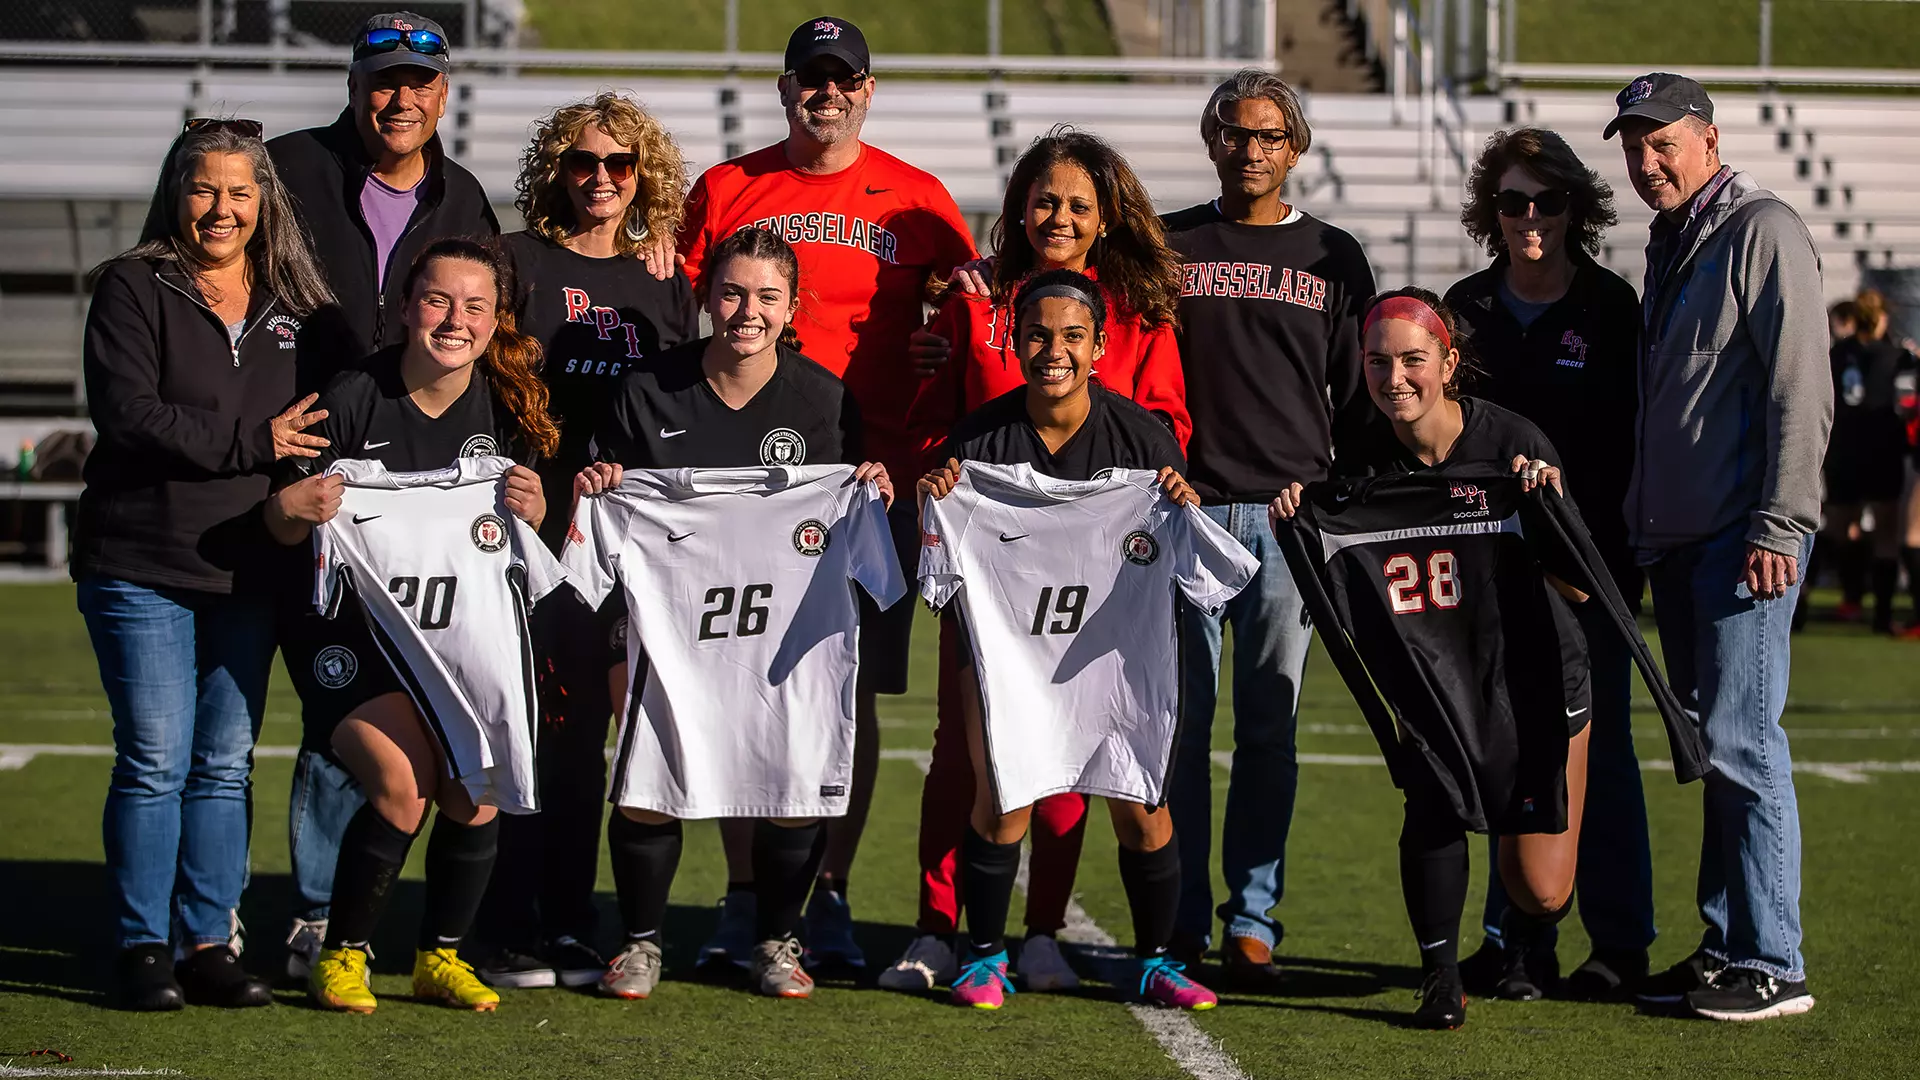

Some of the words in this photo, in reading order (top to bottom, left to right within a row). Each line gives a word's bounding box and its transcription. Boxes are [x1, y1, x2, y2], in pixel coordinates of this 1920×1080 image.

[737, 212, 899, 264] NSSELAER
[562, 287, 643, 358] RPI
[279, 341, 296, 349] MOM
[1556, 359, 1585, 368] SOCCER
[1561, 330, 1587, 361] RPI
[565, 359, 632, 376] SOCC
[1448, 480, 1488, 510] RPI
[1453, 510, 1489, 519] SOCCER
[1384, 550, 1461, 614] 28
[389, 576, 458, 630] 20
[698, 583, 773, 641] 26
[1030, 586, 1089, 635] 19
